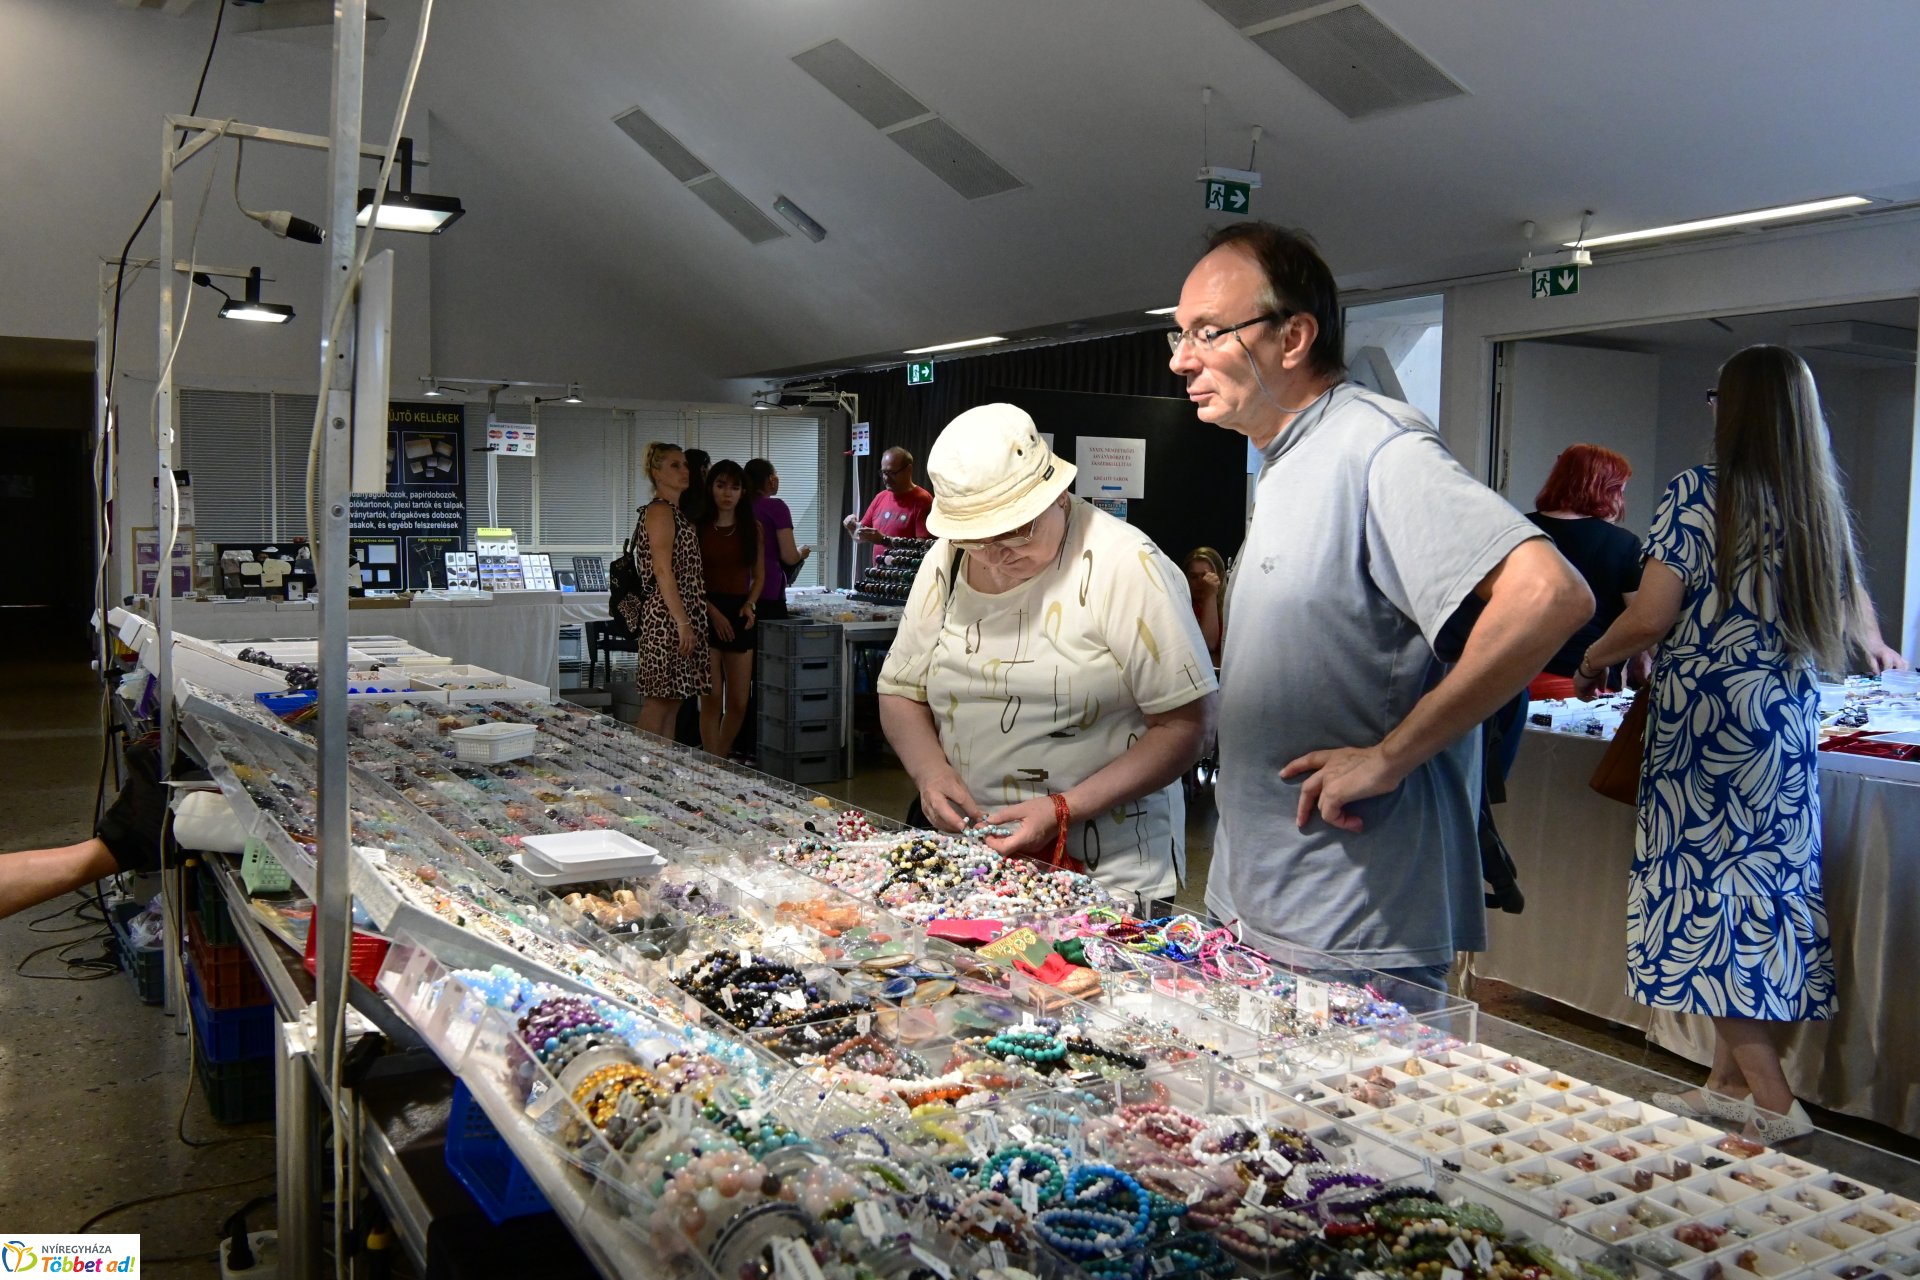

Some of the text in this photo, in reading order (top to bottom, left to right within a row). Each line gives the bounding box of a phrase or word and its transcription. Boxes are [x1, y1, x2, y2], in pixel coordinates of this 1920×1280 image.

[388, 408, 460, 424] ŰJTŐ KELLÉKEK
[349, 500, 392, 509] olókartonok,
[394, 501, 410, 510] plexi
[443, 501, 466, 510] talpak,
[349, 510, 462, 520] ványtartók, drágaköves dobozok,
[349, 521, 376, 529] asakok,
[388, 520, 413, 530] egyébb
